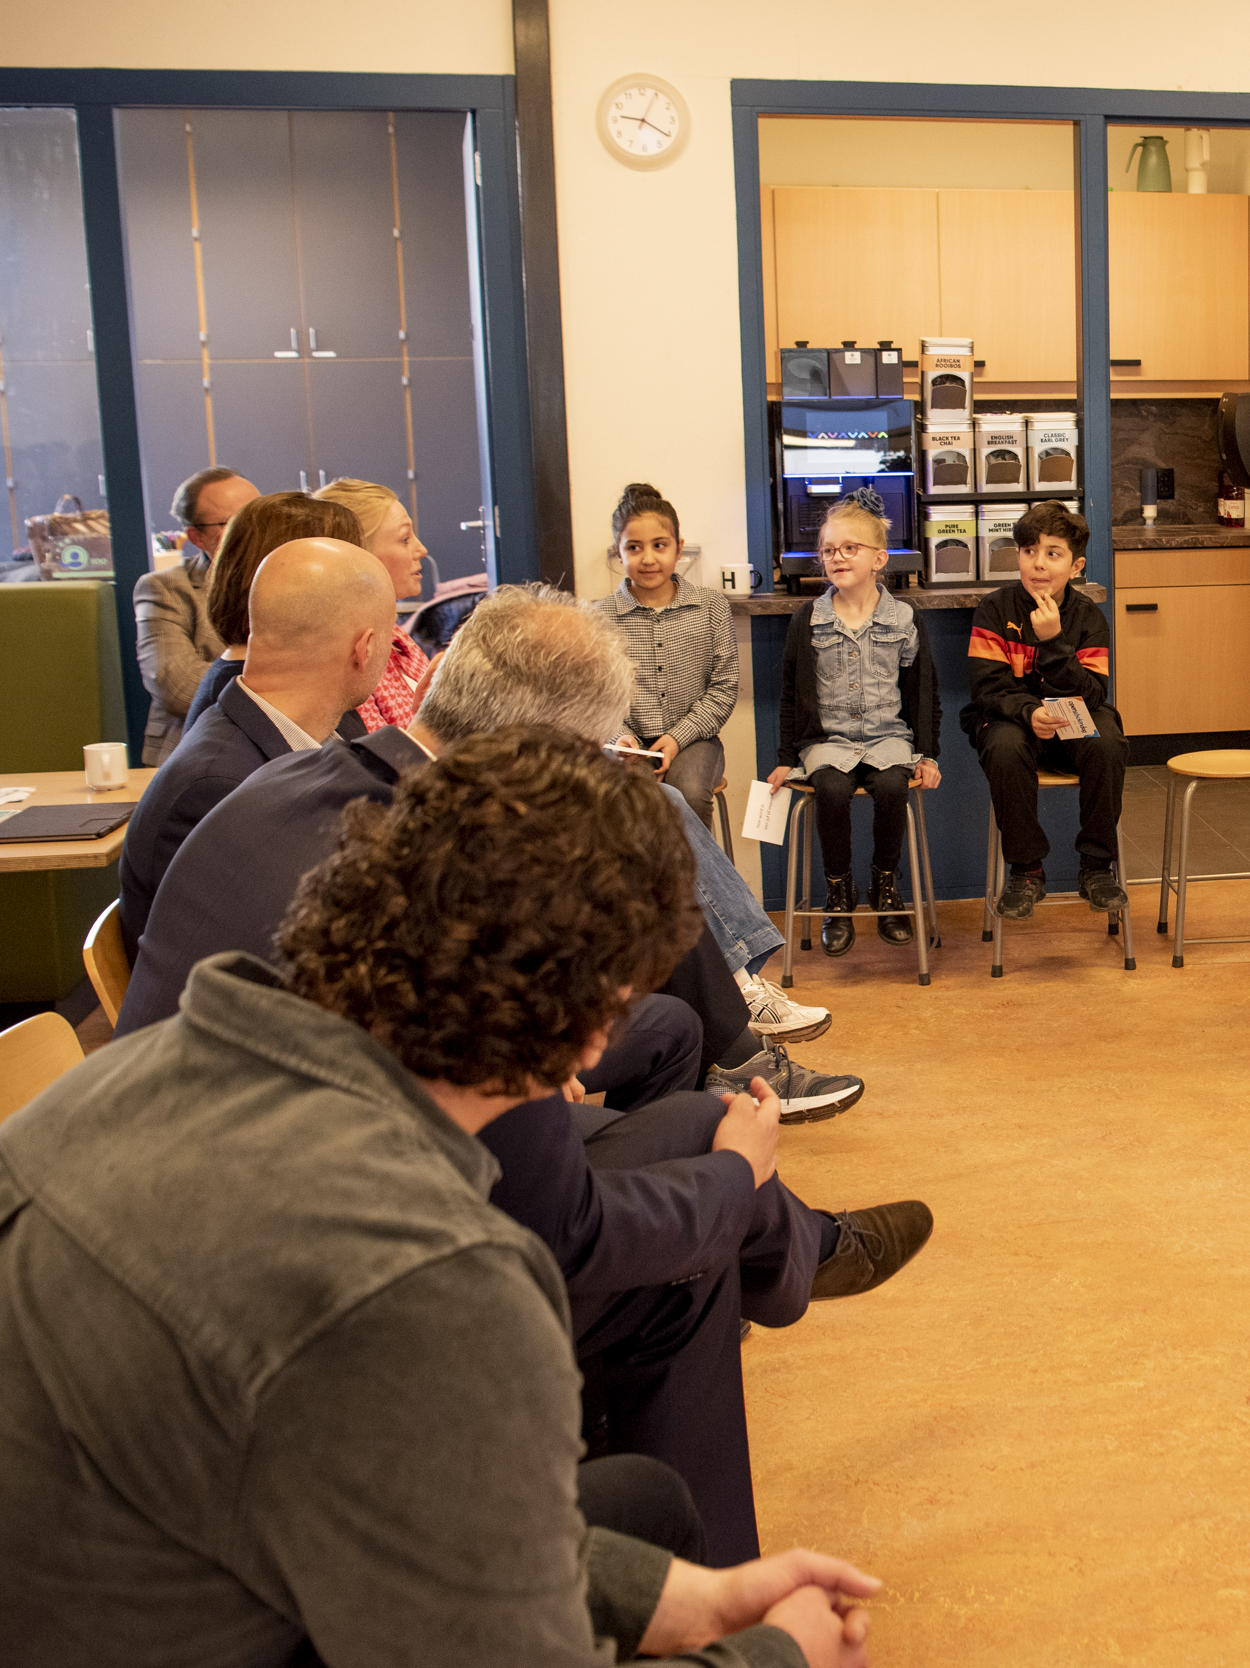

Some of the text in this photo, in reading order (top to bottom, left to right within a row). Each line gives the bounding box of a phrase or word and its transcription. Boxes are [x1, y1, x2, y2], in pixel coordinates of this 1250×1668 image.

[638, 87, 647, 96] 12
[624, 92, 632, 100] 11
[615, 102, 623, 110] 10
[665, 102, 672, 110] 2
[611, 116, 618, 124] 9
[669, 116, 676, 124] 3
[616, 130, 623, 138] 8
[628, 139, 634, 147] 7
[657, 140, 663, 148] 5
[642, 144, 648, 152] 6
[722, 571, 736, 589] H
